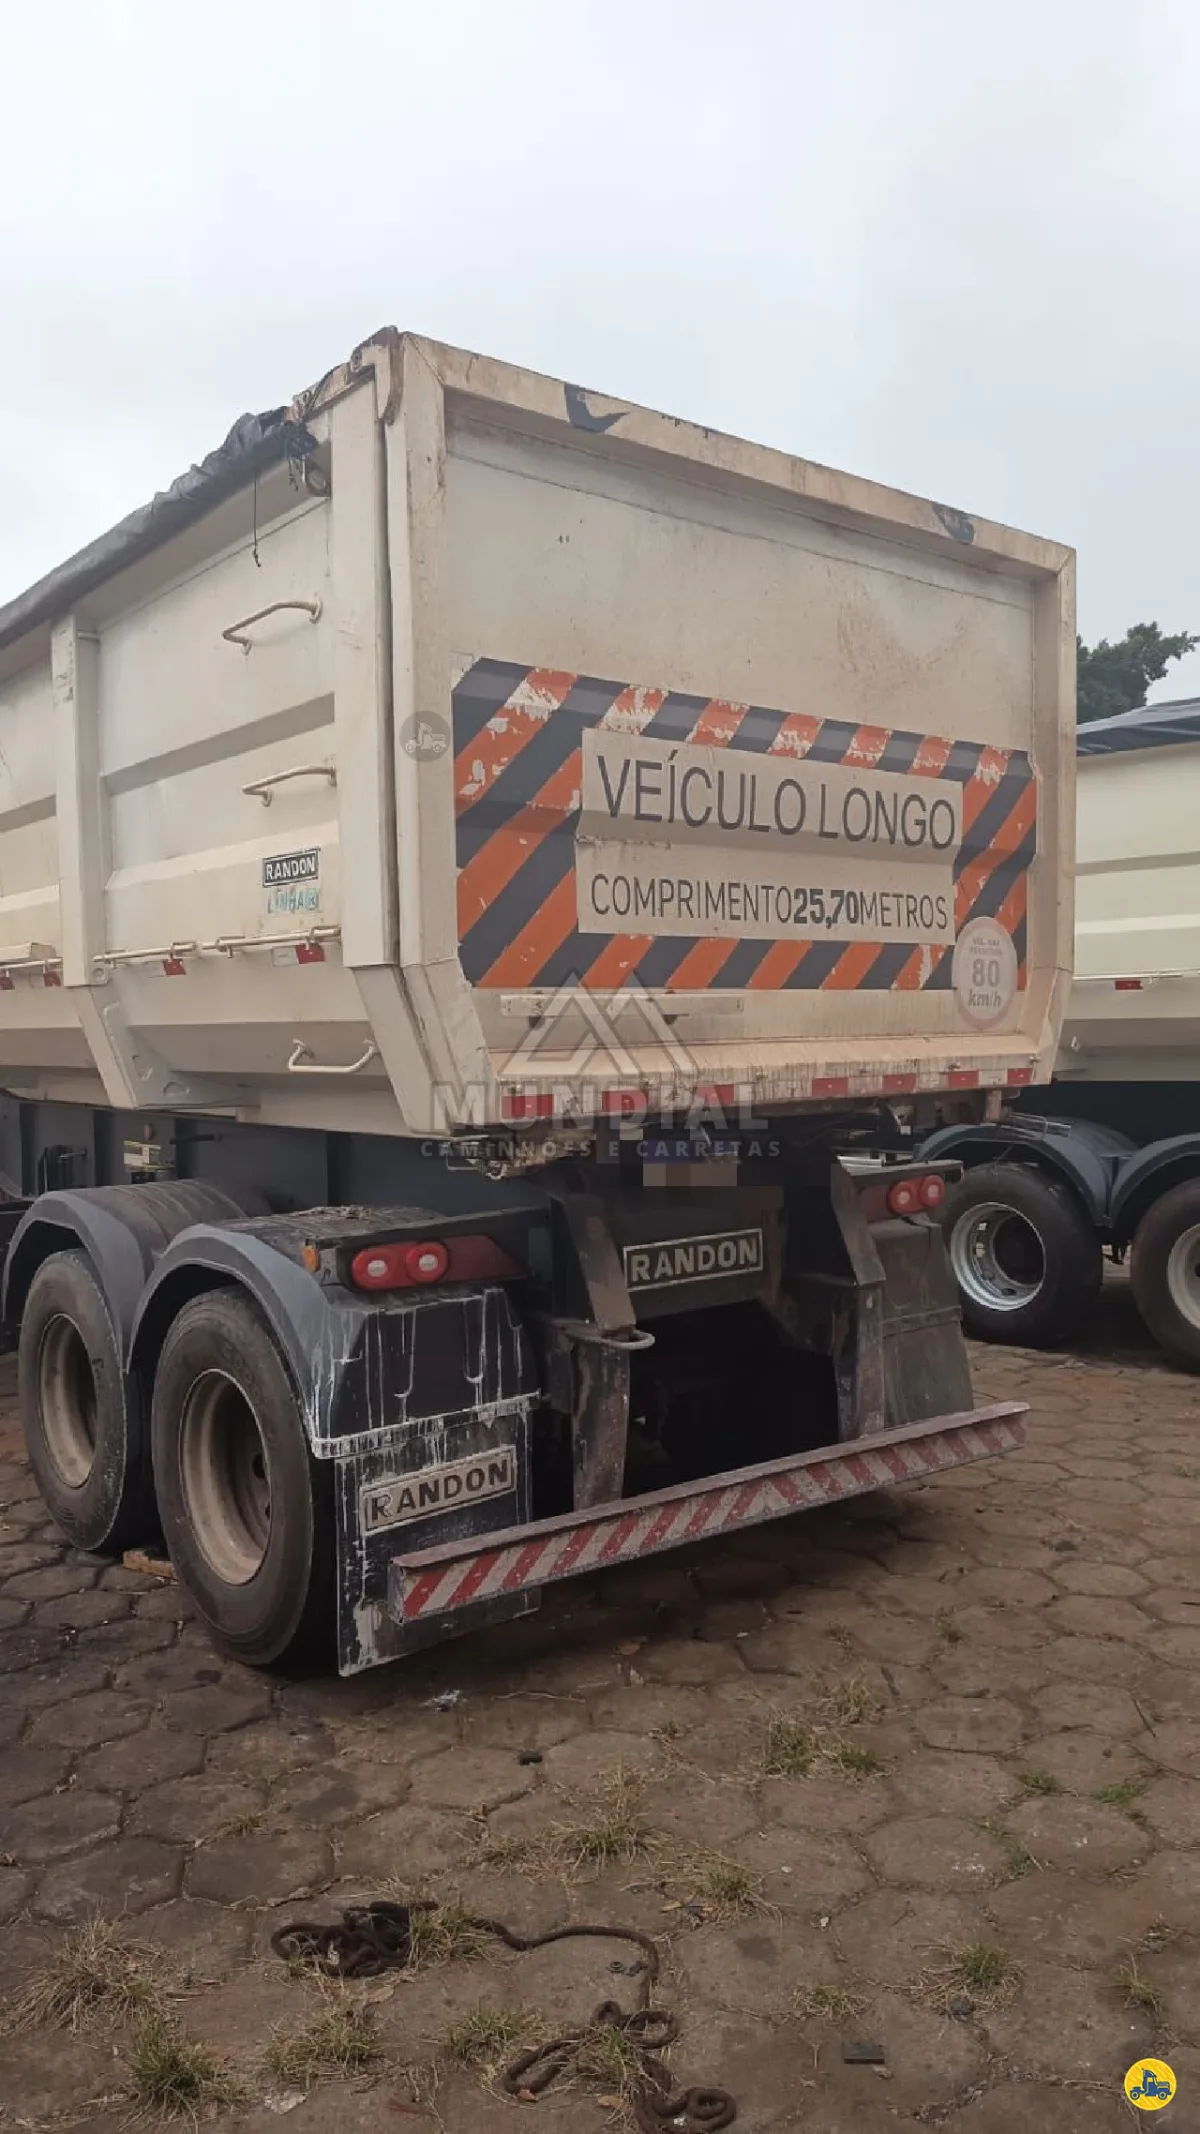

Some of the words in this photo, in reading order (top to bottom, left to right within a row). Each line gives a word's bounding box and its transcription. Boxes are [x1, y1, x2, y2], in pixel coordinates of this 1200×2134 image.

[597, 748, 806, 836] VEÍCULO
[818, 783, 956, 850] LONGO
[266, 856, 315, 880] RANDON
[972, 959, 1000, 987] 80
[967, 988, 1002, 1008] km/h
[630, 1235, 758, 1283] RANDON
[371, 1458, 508, 1523] RANDON
